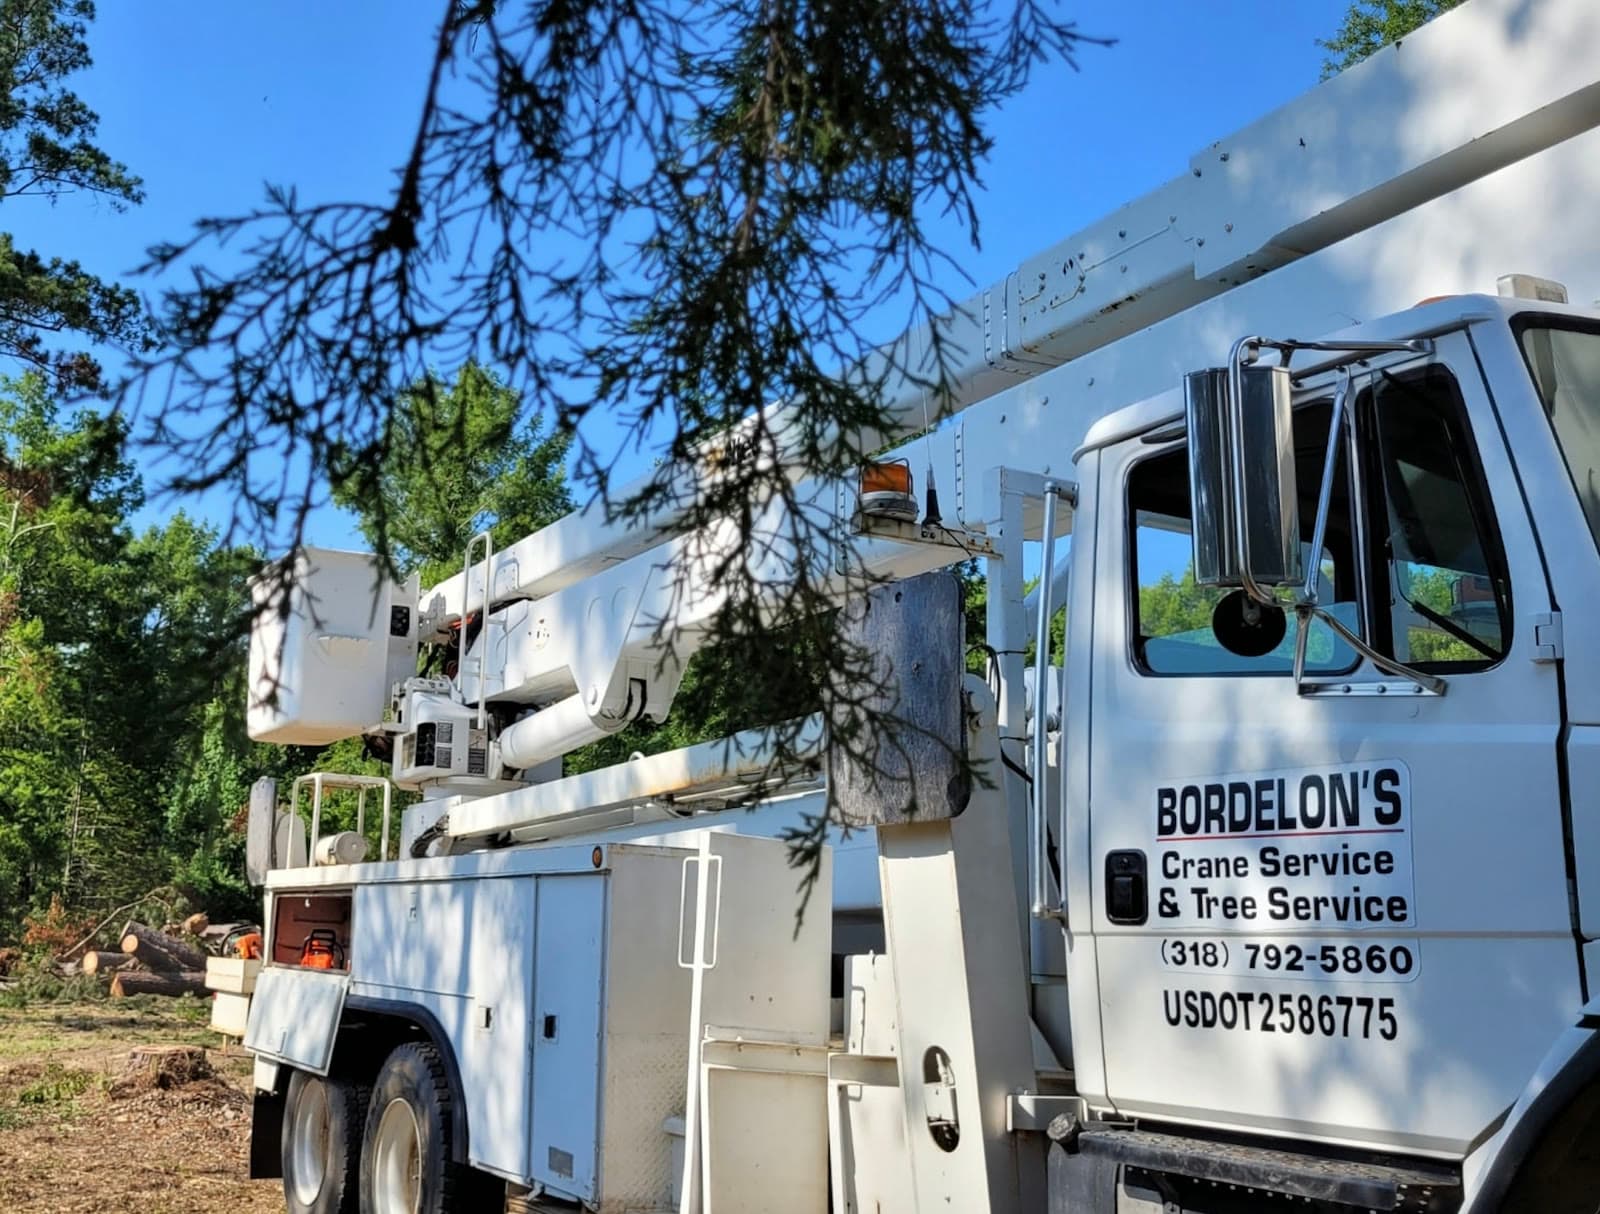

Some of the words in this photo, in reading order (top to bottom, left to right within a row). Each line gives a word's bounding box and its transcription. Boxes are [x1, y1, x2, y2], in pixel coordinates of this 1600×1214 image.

[1157, 768, 1402, 836] BORDELON'S
[1161, 850, 1250, 880] Crane
[1259, 843, 1394, 878] Service
[1158, 887, 1181, 918] &
[1191, 887, 1258, 920] Tree
[1267, 886, 1408, 922] Service
[1161, 938, 1229, 968] (318)
[1244, 943, 1413, 975] 792-5860
